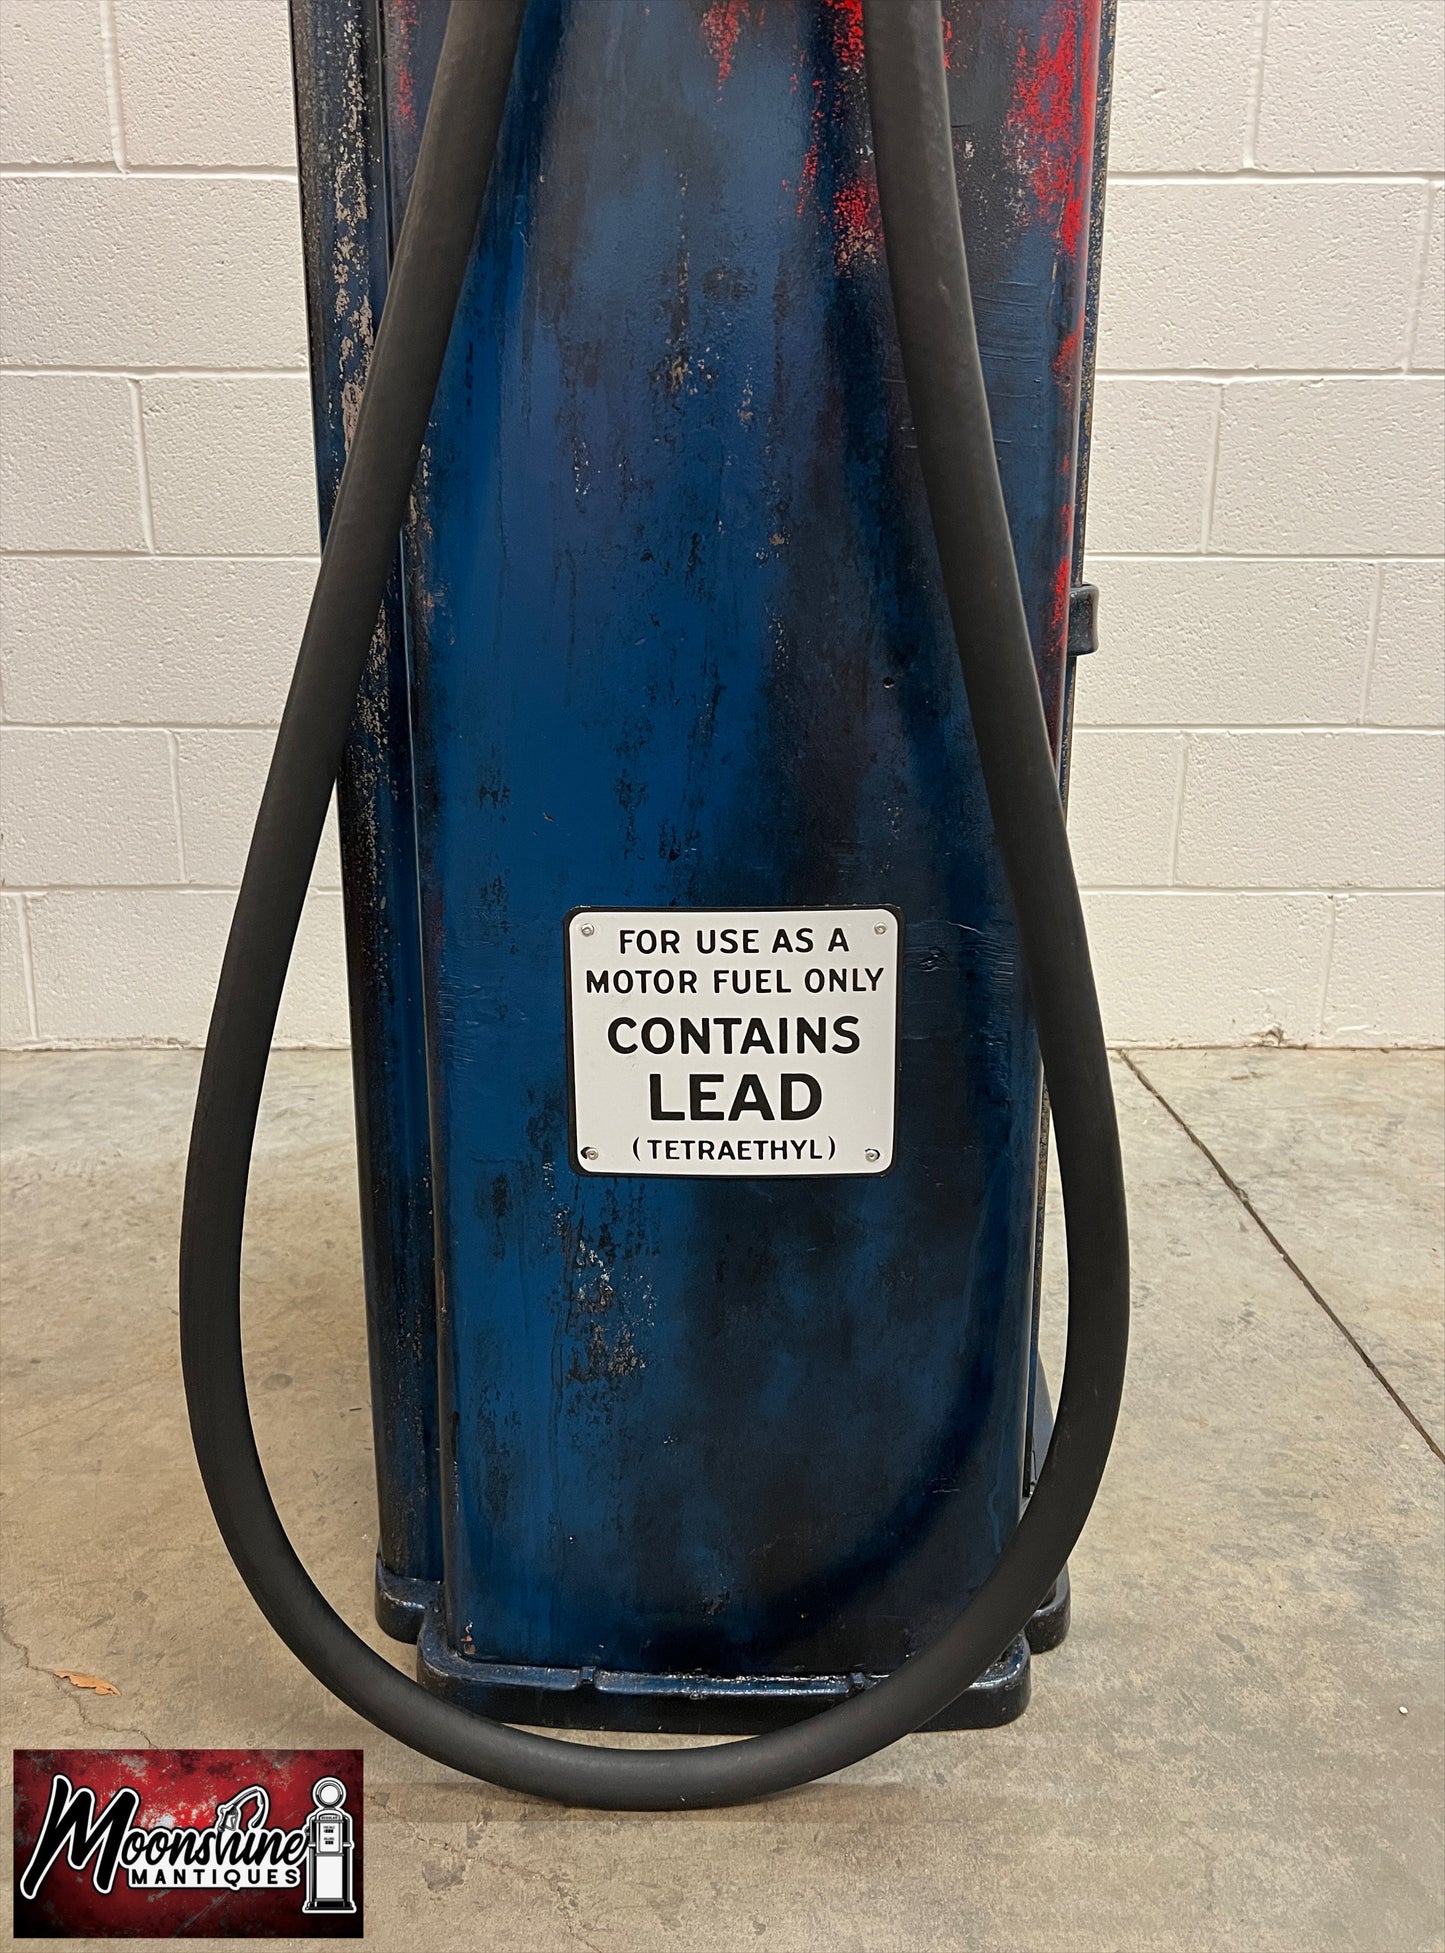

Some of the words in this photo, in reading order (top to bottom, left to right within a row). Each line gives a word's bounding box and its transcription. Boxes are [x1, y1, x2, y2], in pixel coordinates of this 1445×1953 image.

[619, 929, 680, 954] FOR
[696, 928, 760, 954] USE
[771, 927, 814, 953] AS
[827, 927, 850, 952] A
[586, 969, 698, 994] MOTOR
[713, 969, 792, 994] FUEL
[804, 967, 885, 993] ONLY
[607, 1015, 861, 1055] CONTAINS
[649, 1073, 823, 1122] LEAD
[632, 1136, 837, 1162] (TETRAETHYL)
